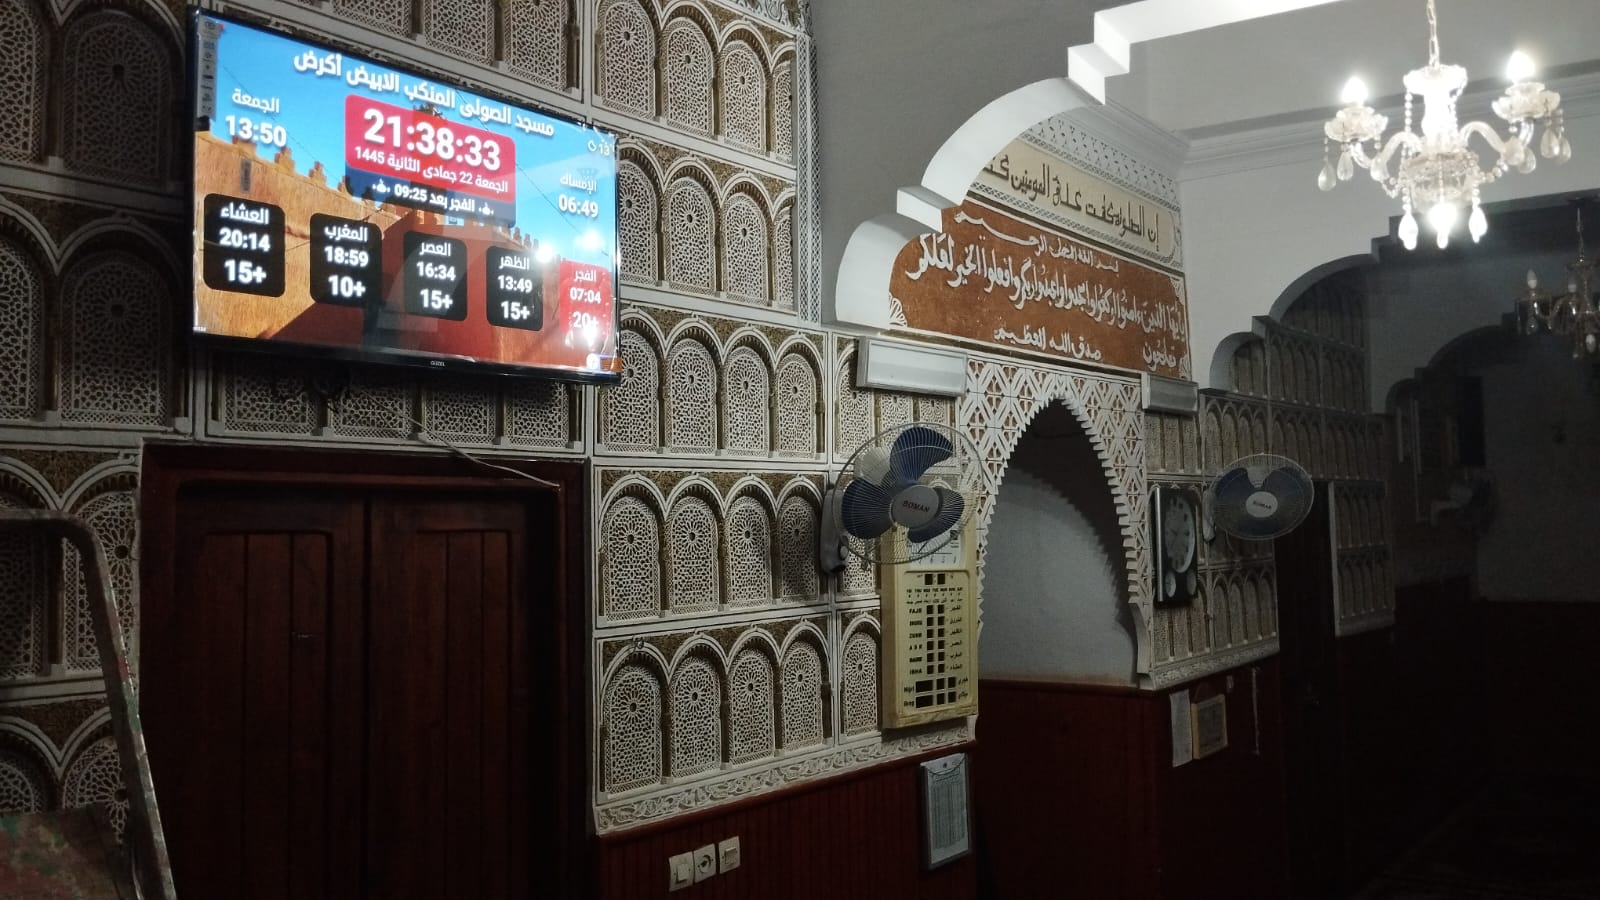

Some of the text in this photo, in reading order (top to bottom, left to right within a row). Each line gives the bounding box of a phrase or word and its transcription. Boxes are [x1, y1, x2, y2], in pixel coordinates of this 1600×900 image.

[346, 65, 399, 92] الابيض
[232, 88, 280, 113] الجمعة
[404, 84, 455, 108] المنكب
[226, 115, 287, 147] 13:50
[515, 115, 554, 136] مسجد
[364, 108, 500, 170] 21:38:33
[355, 147, 385, 164] 1445
[387, 152, 420, 172] الثانية
[459, 173, 472, 184] 22
[476, 175, 509, 193] الجمعة
[394, 185, 475, 212] الفجر بعد 09:25
[558, 195, 599, 217] 06:49
[221, 202, 270, 225] العشاء
[219, 228, 271, 252] 20:14
[324, 224, 368, 242] المغرب
[324, 246, 369, 267] 18:59
[419, 242, 451, 257] العصر
[416, 261, 456, 281] 16:34
[499, 255, 530, 270] الظهر
[497, 275, 533, 293] 13:49
[574, 269, 597, 282] الفجر
[569, 288, 602, 304] 07:04
